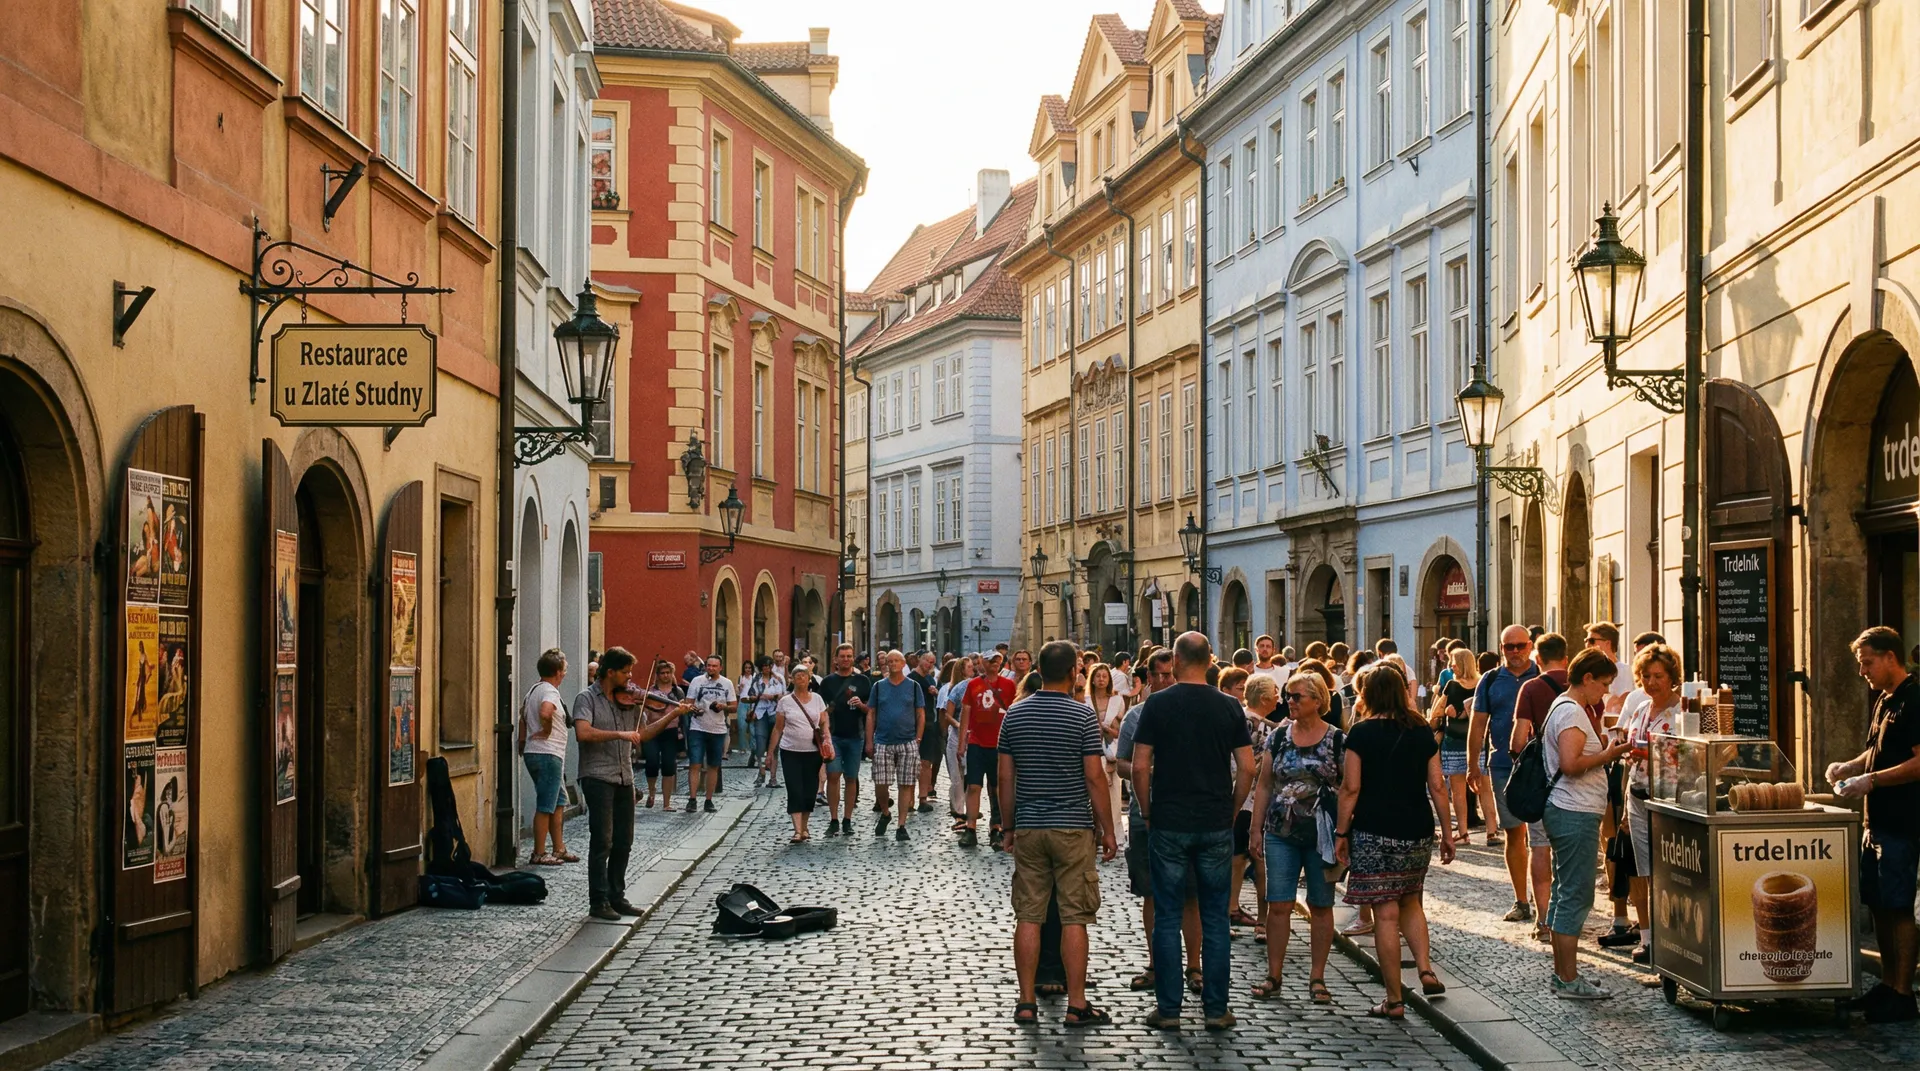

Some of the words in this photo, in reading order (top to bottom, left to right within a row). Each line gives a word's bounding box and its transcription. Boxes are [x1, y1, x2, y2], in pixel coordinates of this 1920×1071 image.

[300, 341, 408, 366] Restaurace
[284, 386, 296, 406] u
[301, 380, 350, 406] Zlaté
[355, 380, 424, 413] Studny
[1883, 421, 1920, 482] trde
[1722, 553, 1760, 573] Trdelník
[1660, 832, 1702, 873] trdelník
[1732, 838, 1833, 862] trdelník
